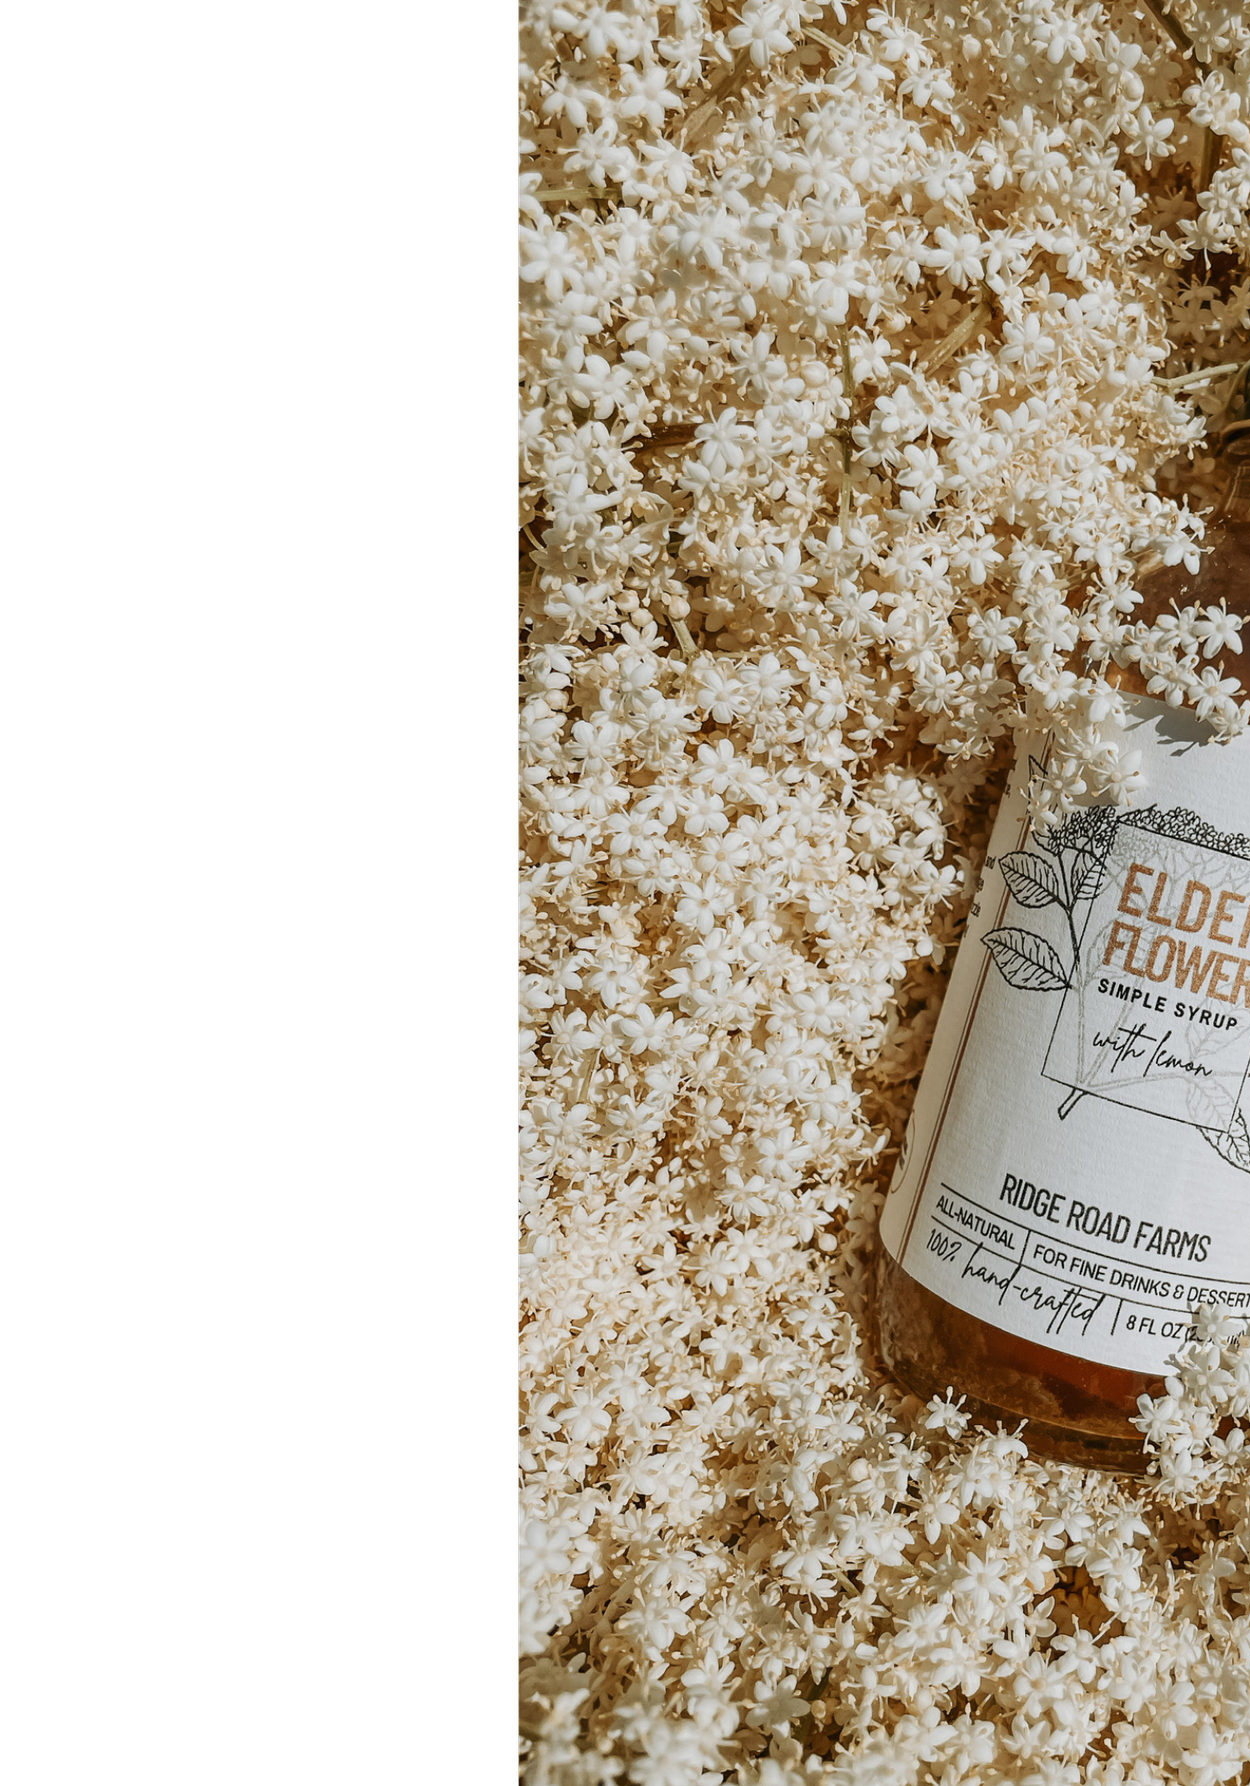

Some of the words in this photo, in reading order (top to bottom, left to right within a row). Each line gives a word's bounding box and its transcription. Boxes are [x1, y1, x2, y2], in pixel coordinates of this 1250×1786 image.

[1098, 978, 1167, 1013] SIMPLE
[1174, 1002, 1238, 1031] SYRUP
[1093, 1023, 1157, 1073] with
[1143, 1030, 1212, 1077] lemon
[936, 1195, 1015, 1250] ALL-NATURAL
[999, 1173, 1066, 1223] RIDGE
[1066, 1200, 1131, 1244] ROAD
[1133, 1221, 1211, 1262] FARMS
[926, 1229, 962, 1262] 100%
[962, 1242, 1106, 1336] hand-crafted
[1033, 1244, 1067, 1269] FOR
[1069, 1257, 1107, 1282] FINE
[1109, 1269, 1171, 1298] DRINKS
[1172, 1285, 1184, 1300] &
[1126, 1315, 1137, 1330] 8
[1139, 1317, 1156, 1335] FL
[1161, 1321, 1184, 1339] OZ
